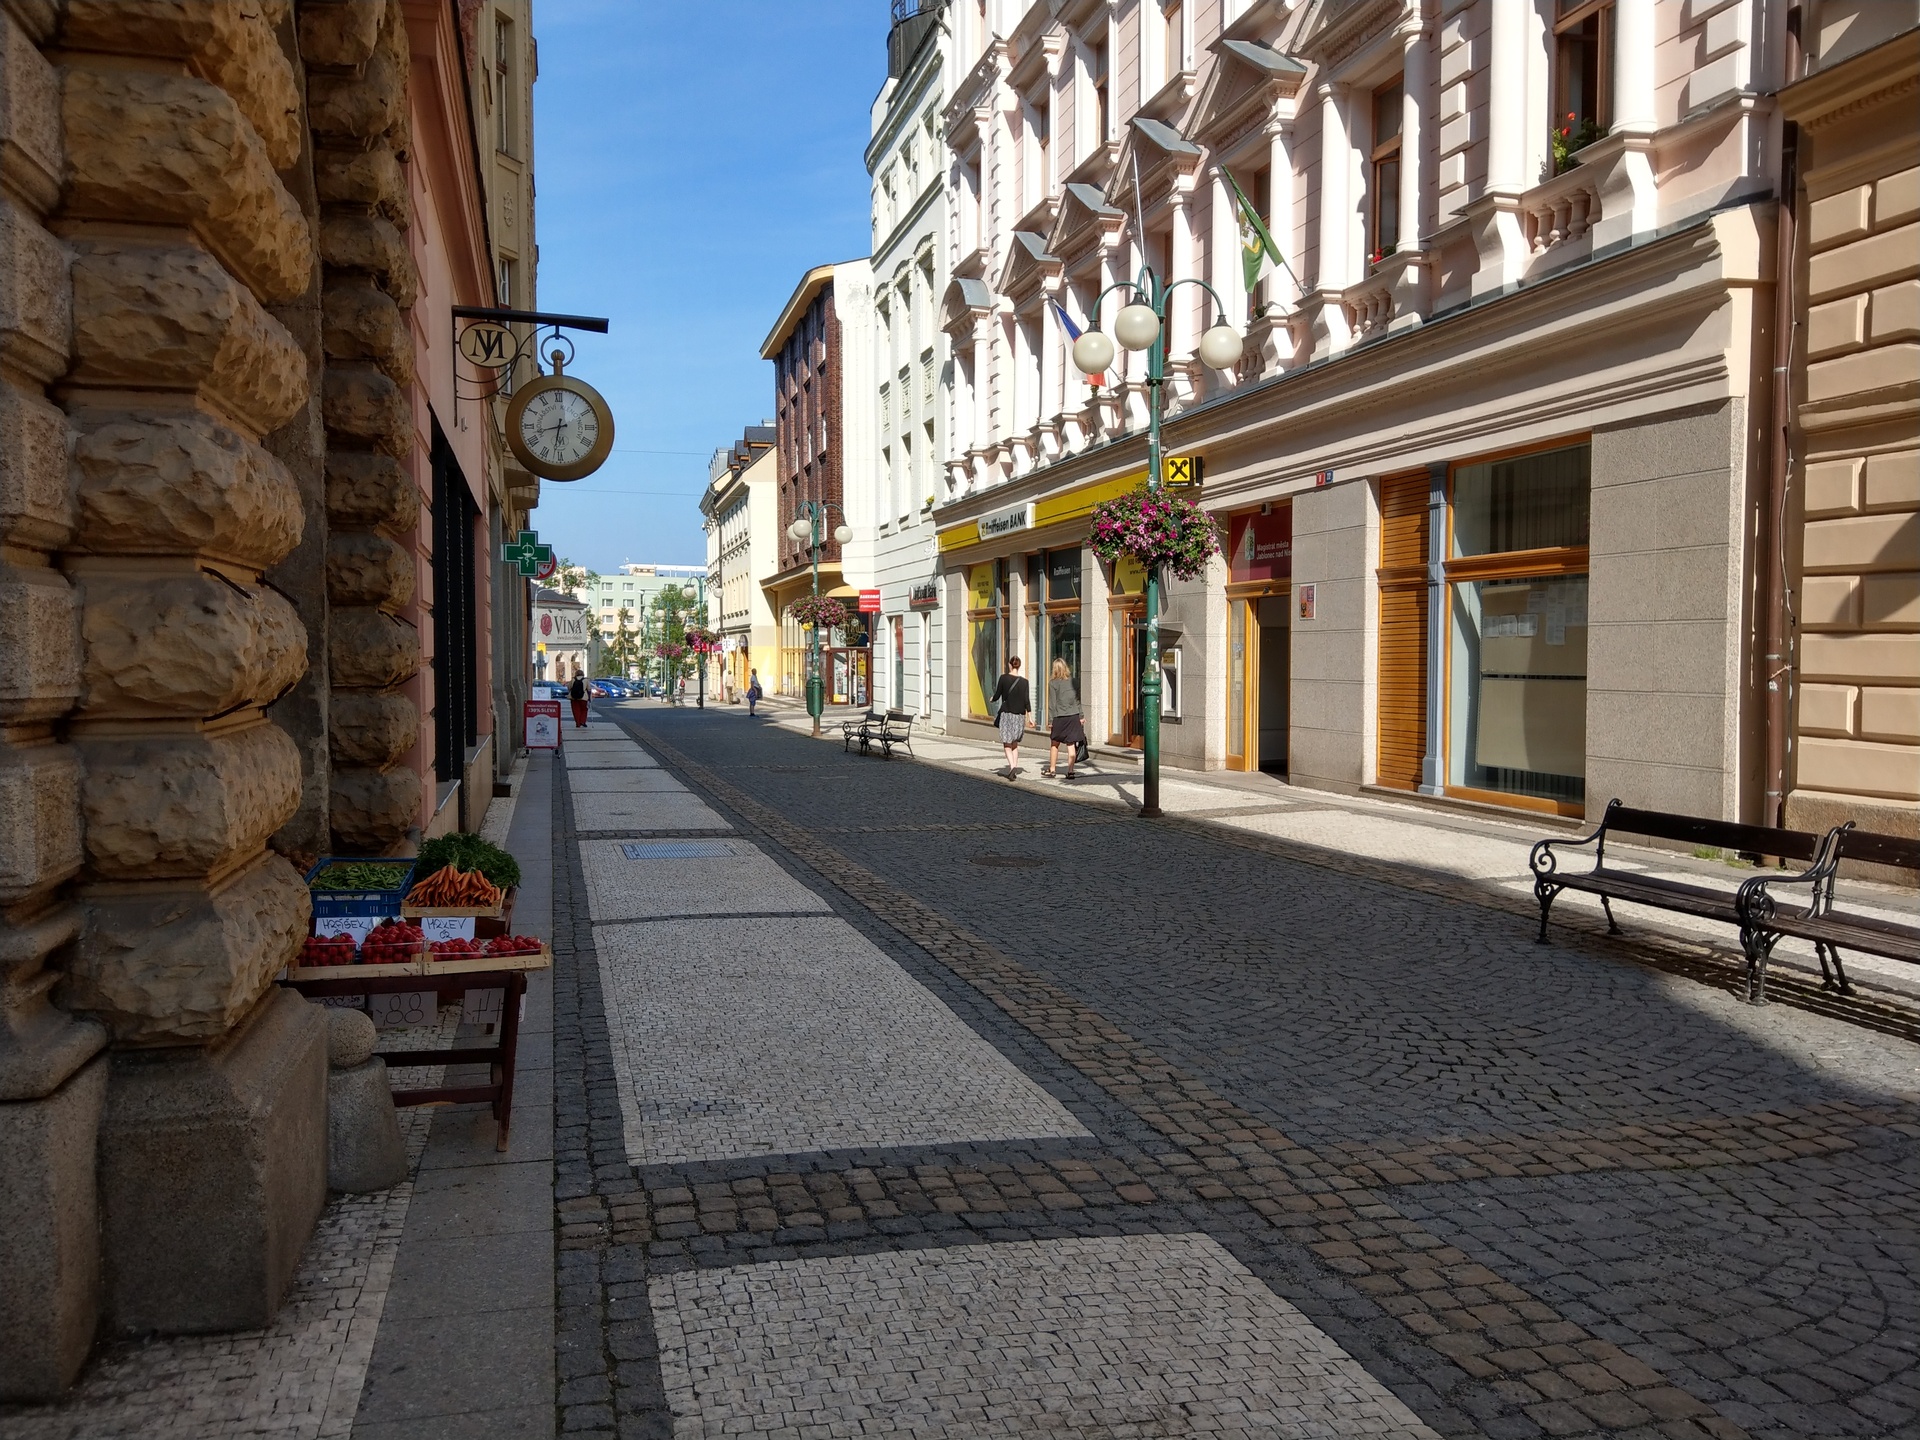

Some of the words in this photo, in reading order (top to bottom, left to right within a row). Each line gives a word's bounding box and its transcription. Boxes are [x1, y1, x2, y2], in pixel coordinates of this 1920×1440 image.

[986, 516, 1009, 534] Raiffeisen
[1010, 510, 1027, 529] BANK
[1256, 551, 1275, 560] Jablonec
[554, 616, 582, 634] VÍNA
